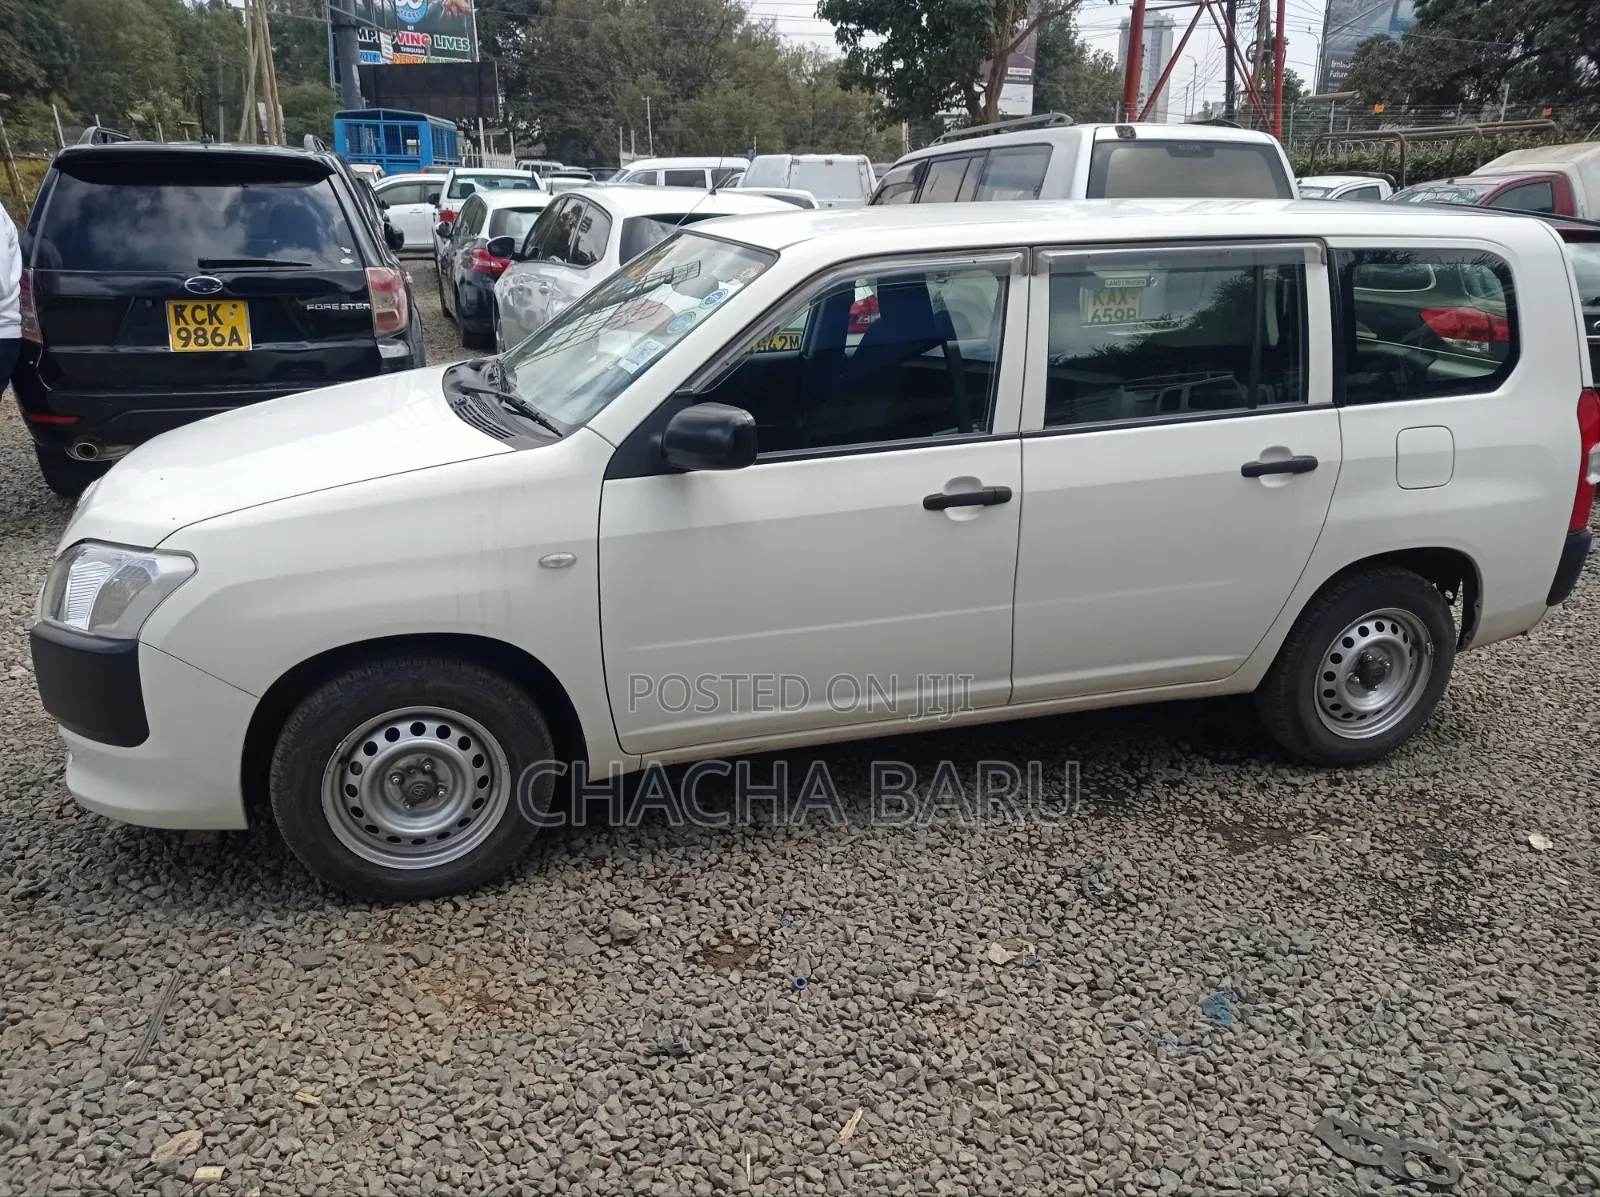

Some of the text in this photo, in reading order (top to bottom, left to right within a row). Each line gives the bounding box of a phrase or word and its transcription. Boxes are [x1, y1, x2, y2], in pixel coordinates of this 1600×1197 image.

[434, 34, 471, 51] LIVES
[360, 50, 382, 64] ATER
[1092, 287, 1128, 306] KAX
[173, 303, 224, 326] KCK
[306, 302, 371, 310] FORESTER
[1090, 307, 1137, 322] 659B
[176, 325, 244, 348] 986A
